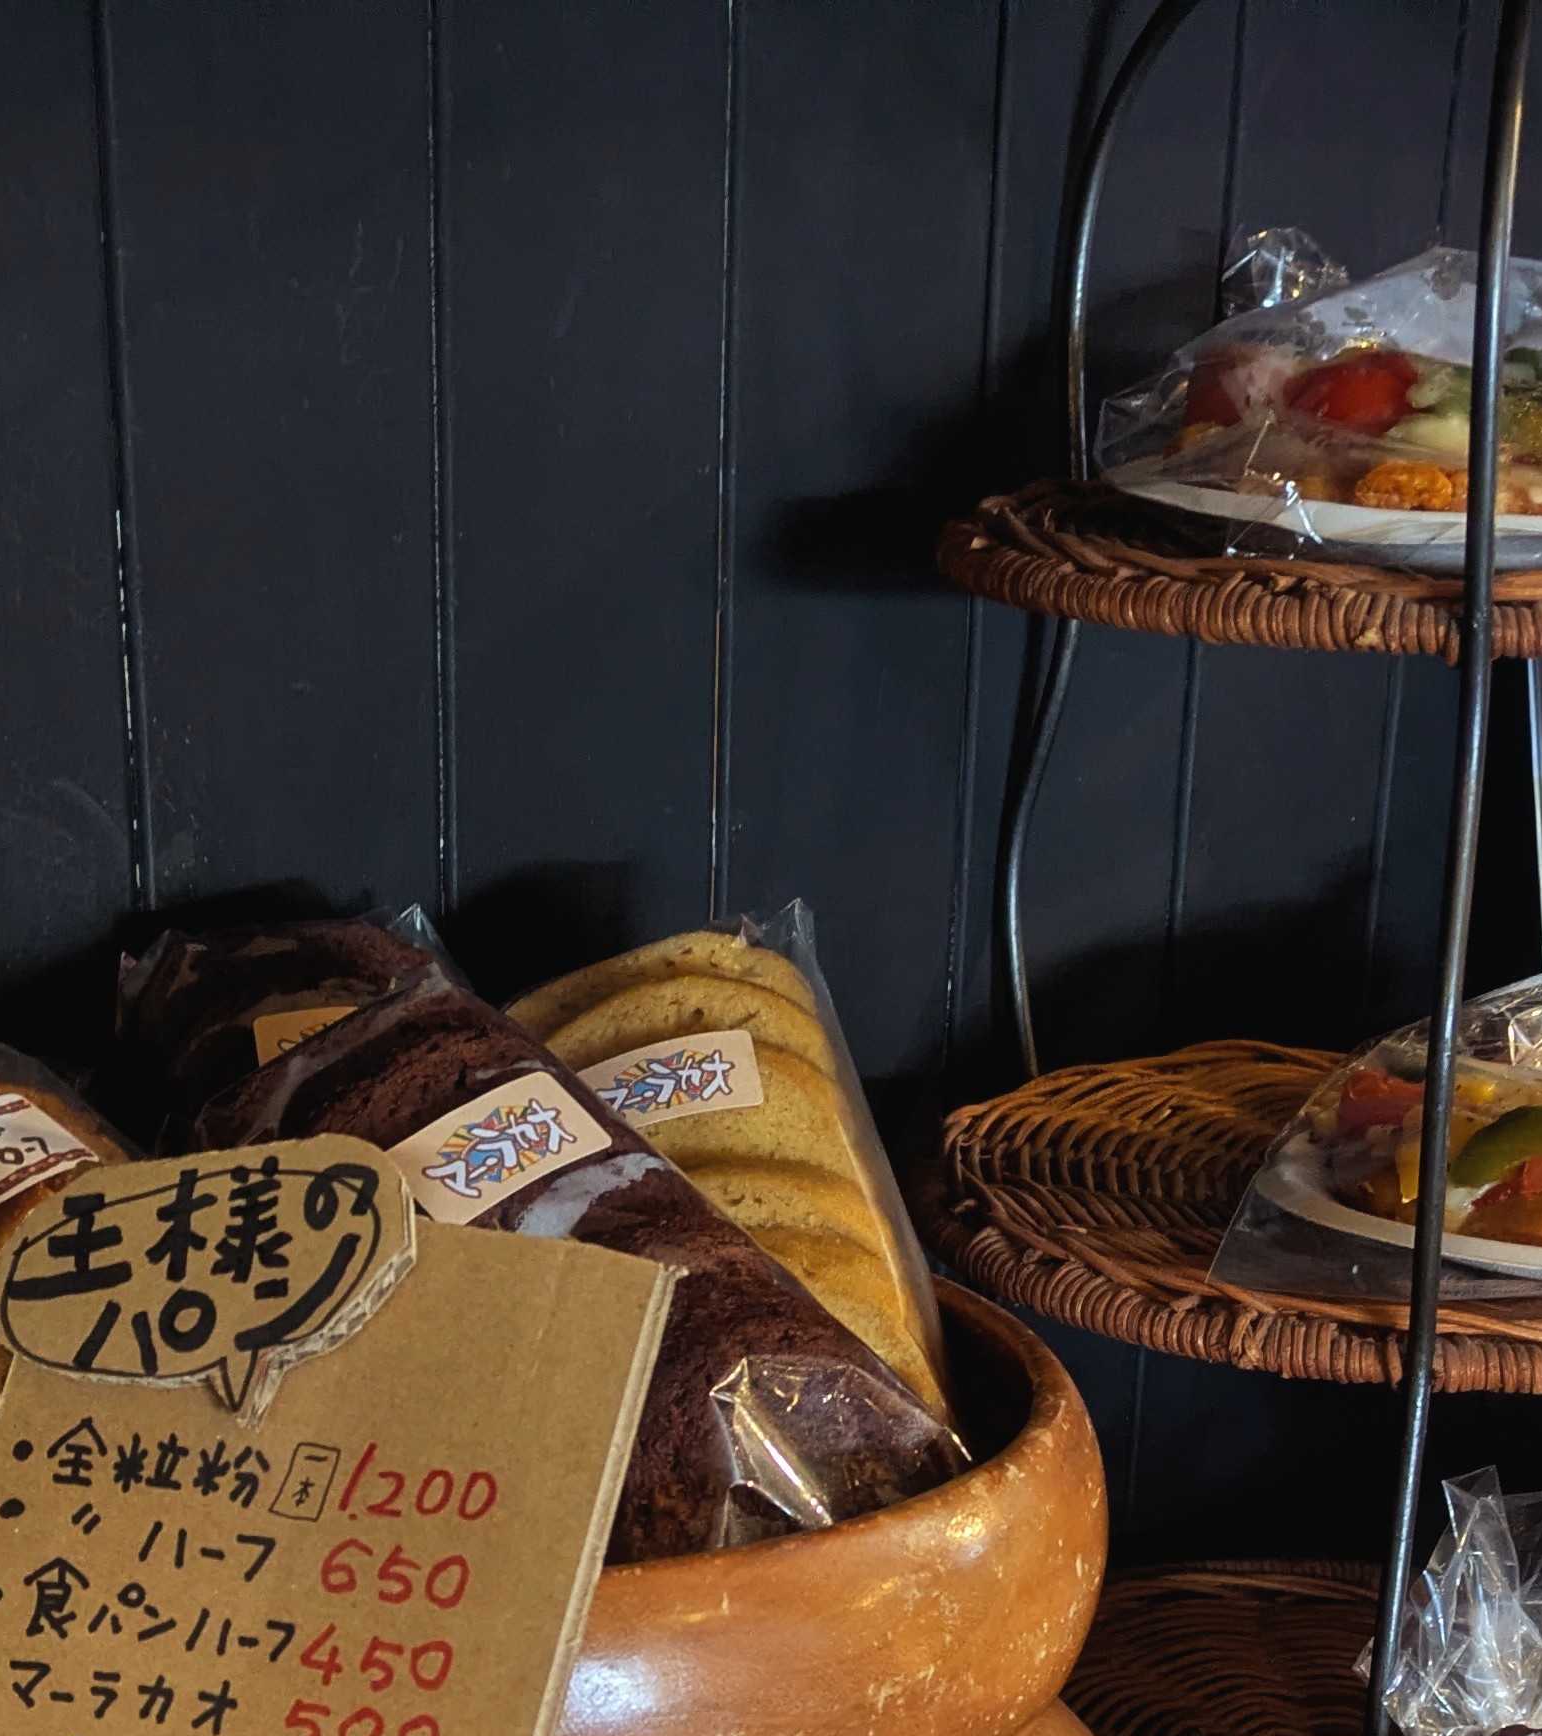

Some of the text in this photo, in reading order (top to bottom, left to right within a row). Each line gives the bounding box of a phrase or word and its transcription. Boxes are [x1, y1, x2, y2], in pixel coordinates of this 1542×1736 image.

[9, 1157, 380, 1300] 王様の
[74, 1233, 362, 1375] パン
[47, 1416, 272, 1508] 全粒粉
[138, 1521, 277, 1582] ハーフ
[320, 1538, 472, 1610] 650
[24, 1557, 455, 1693] 食パンハーフ 450
[8, 1658, 239, 1736] マーラカオ
